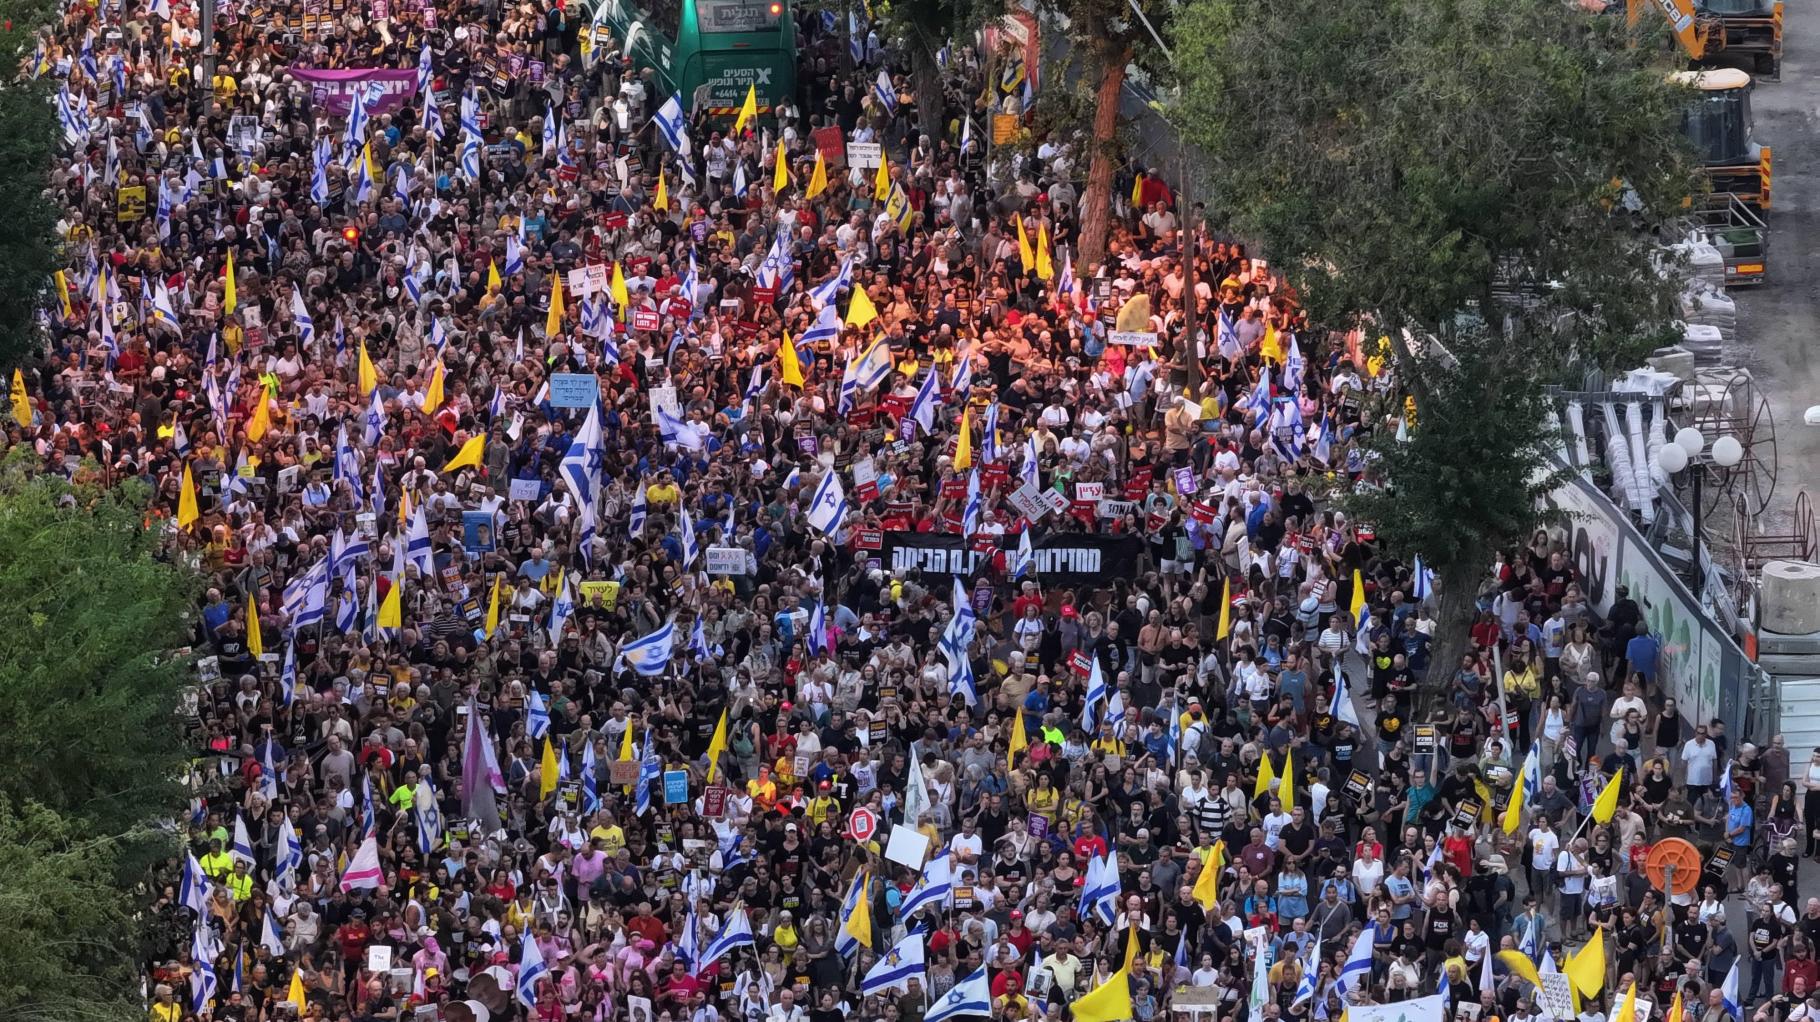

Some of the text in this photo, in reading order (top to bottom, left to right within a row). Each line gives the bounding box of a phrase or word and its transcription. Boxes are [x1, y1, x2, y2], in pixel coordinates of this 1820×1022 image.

[723, 68, 754, 77] הסעים
[892, 546, 947, 574] הביתה
[1034, 548, 1101, 573] מחזירות
